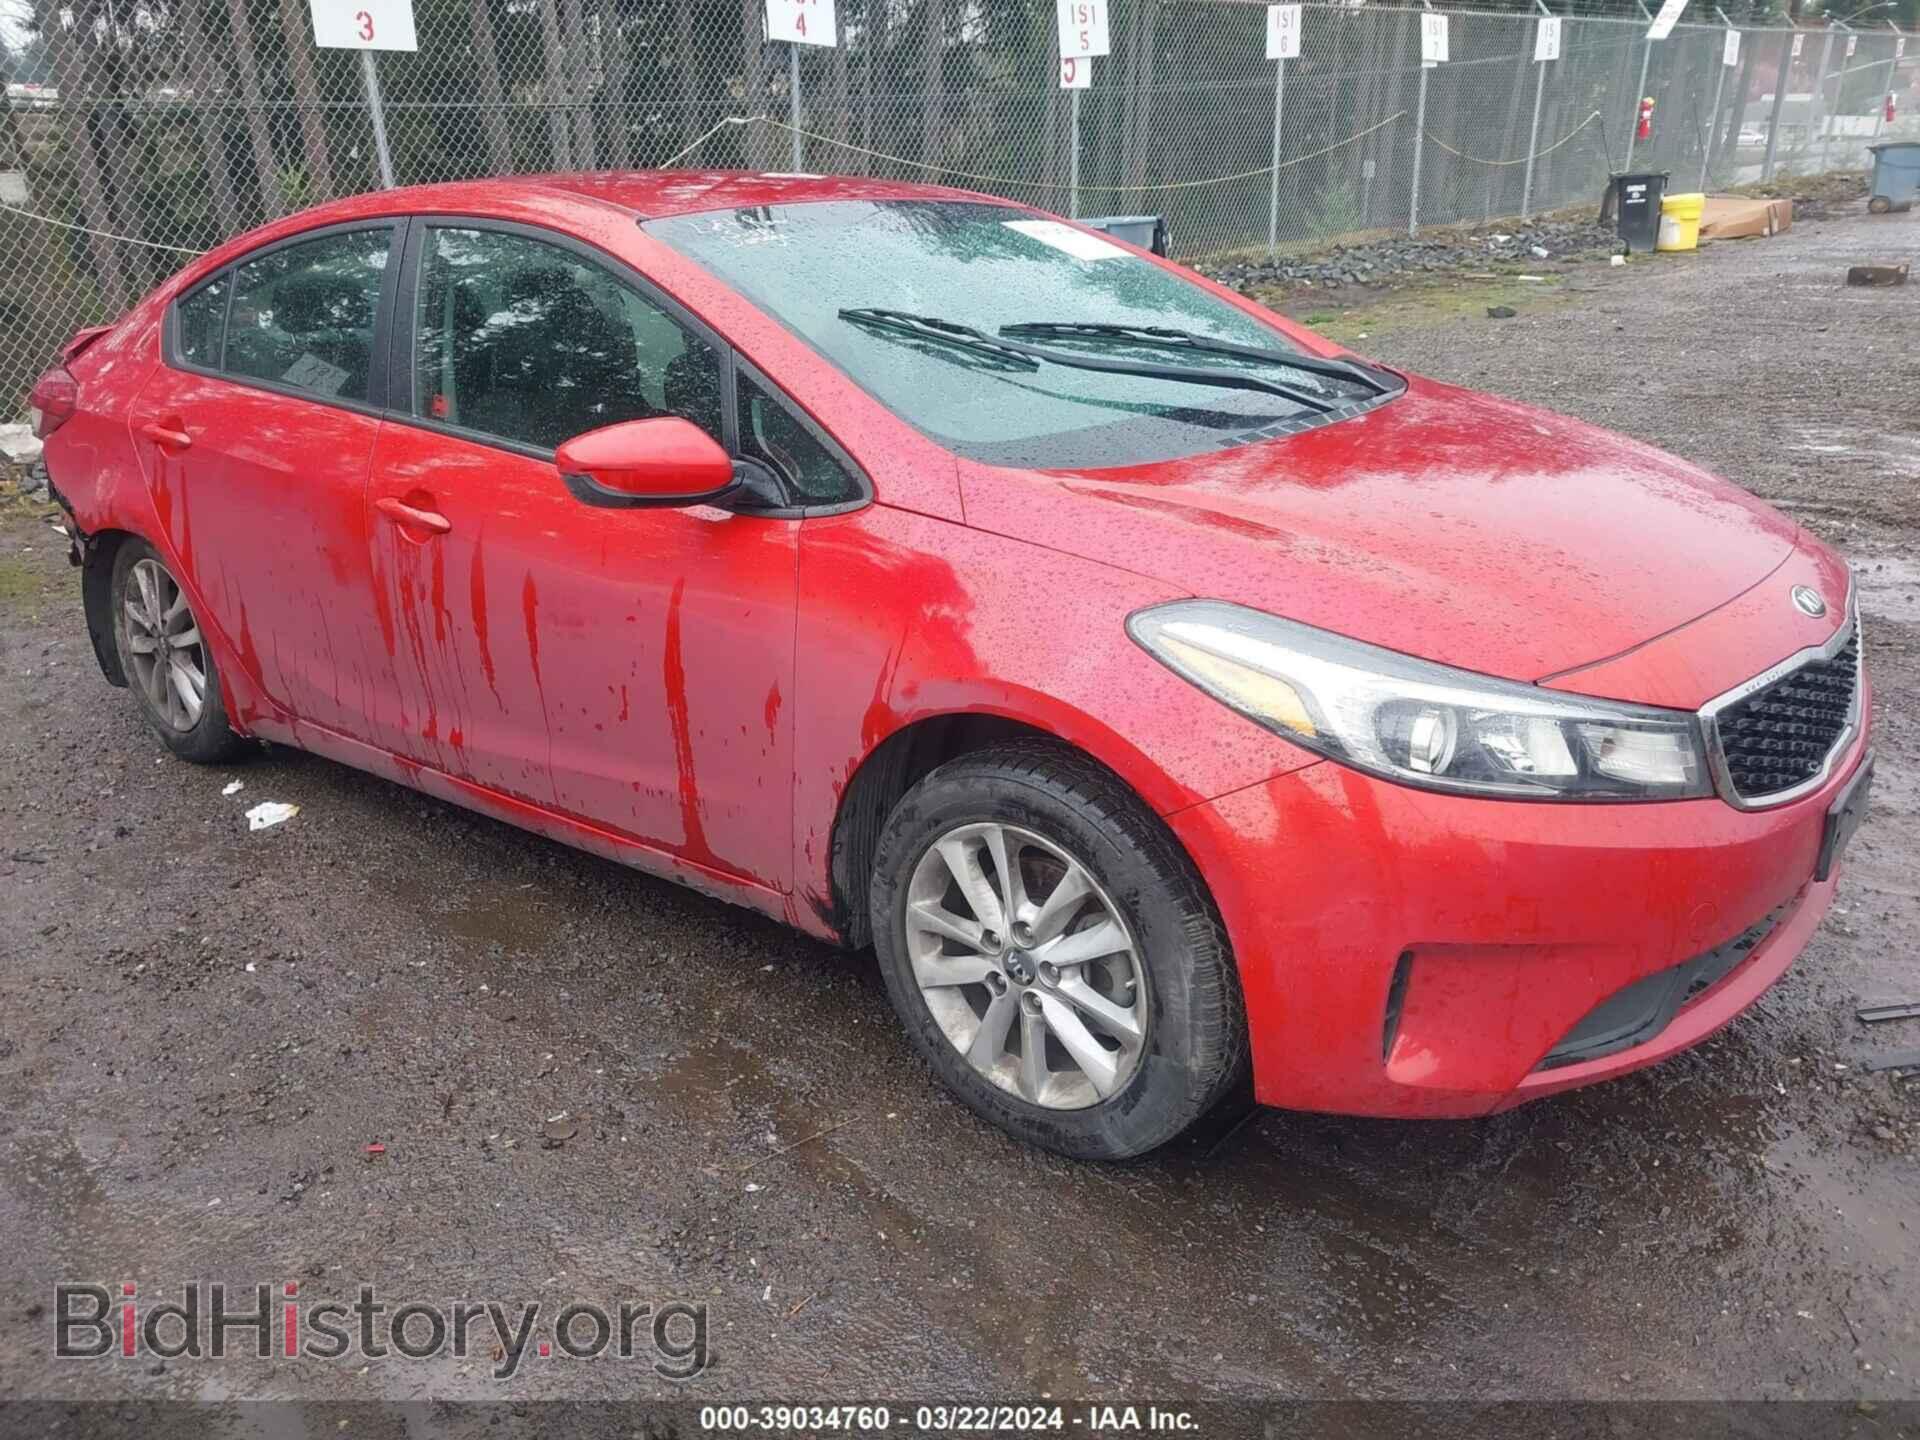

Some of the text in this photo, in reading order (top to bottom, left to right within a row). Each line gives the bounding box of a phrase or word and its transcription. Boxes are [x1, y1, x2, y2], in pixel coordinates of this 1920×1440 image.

[356, 11, 374, 41] 3
[796, 12, 807, 37] 4
[1080, 31, 1089, 50] 5
